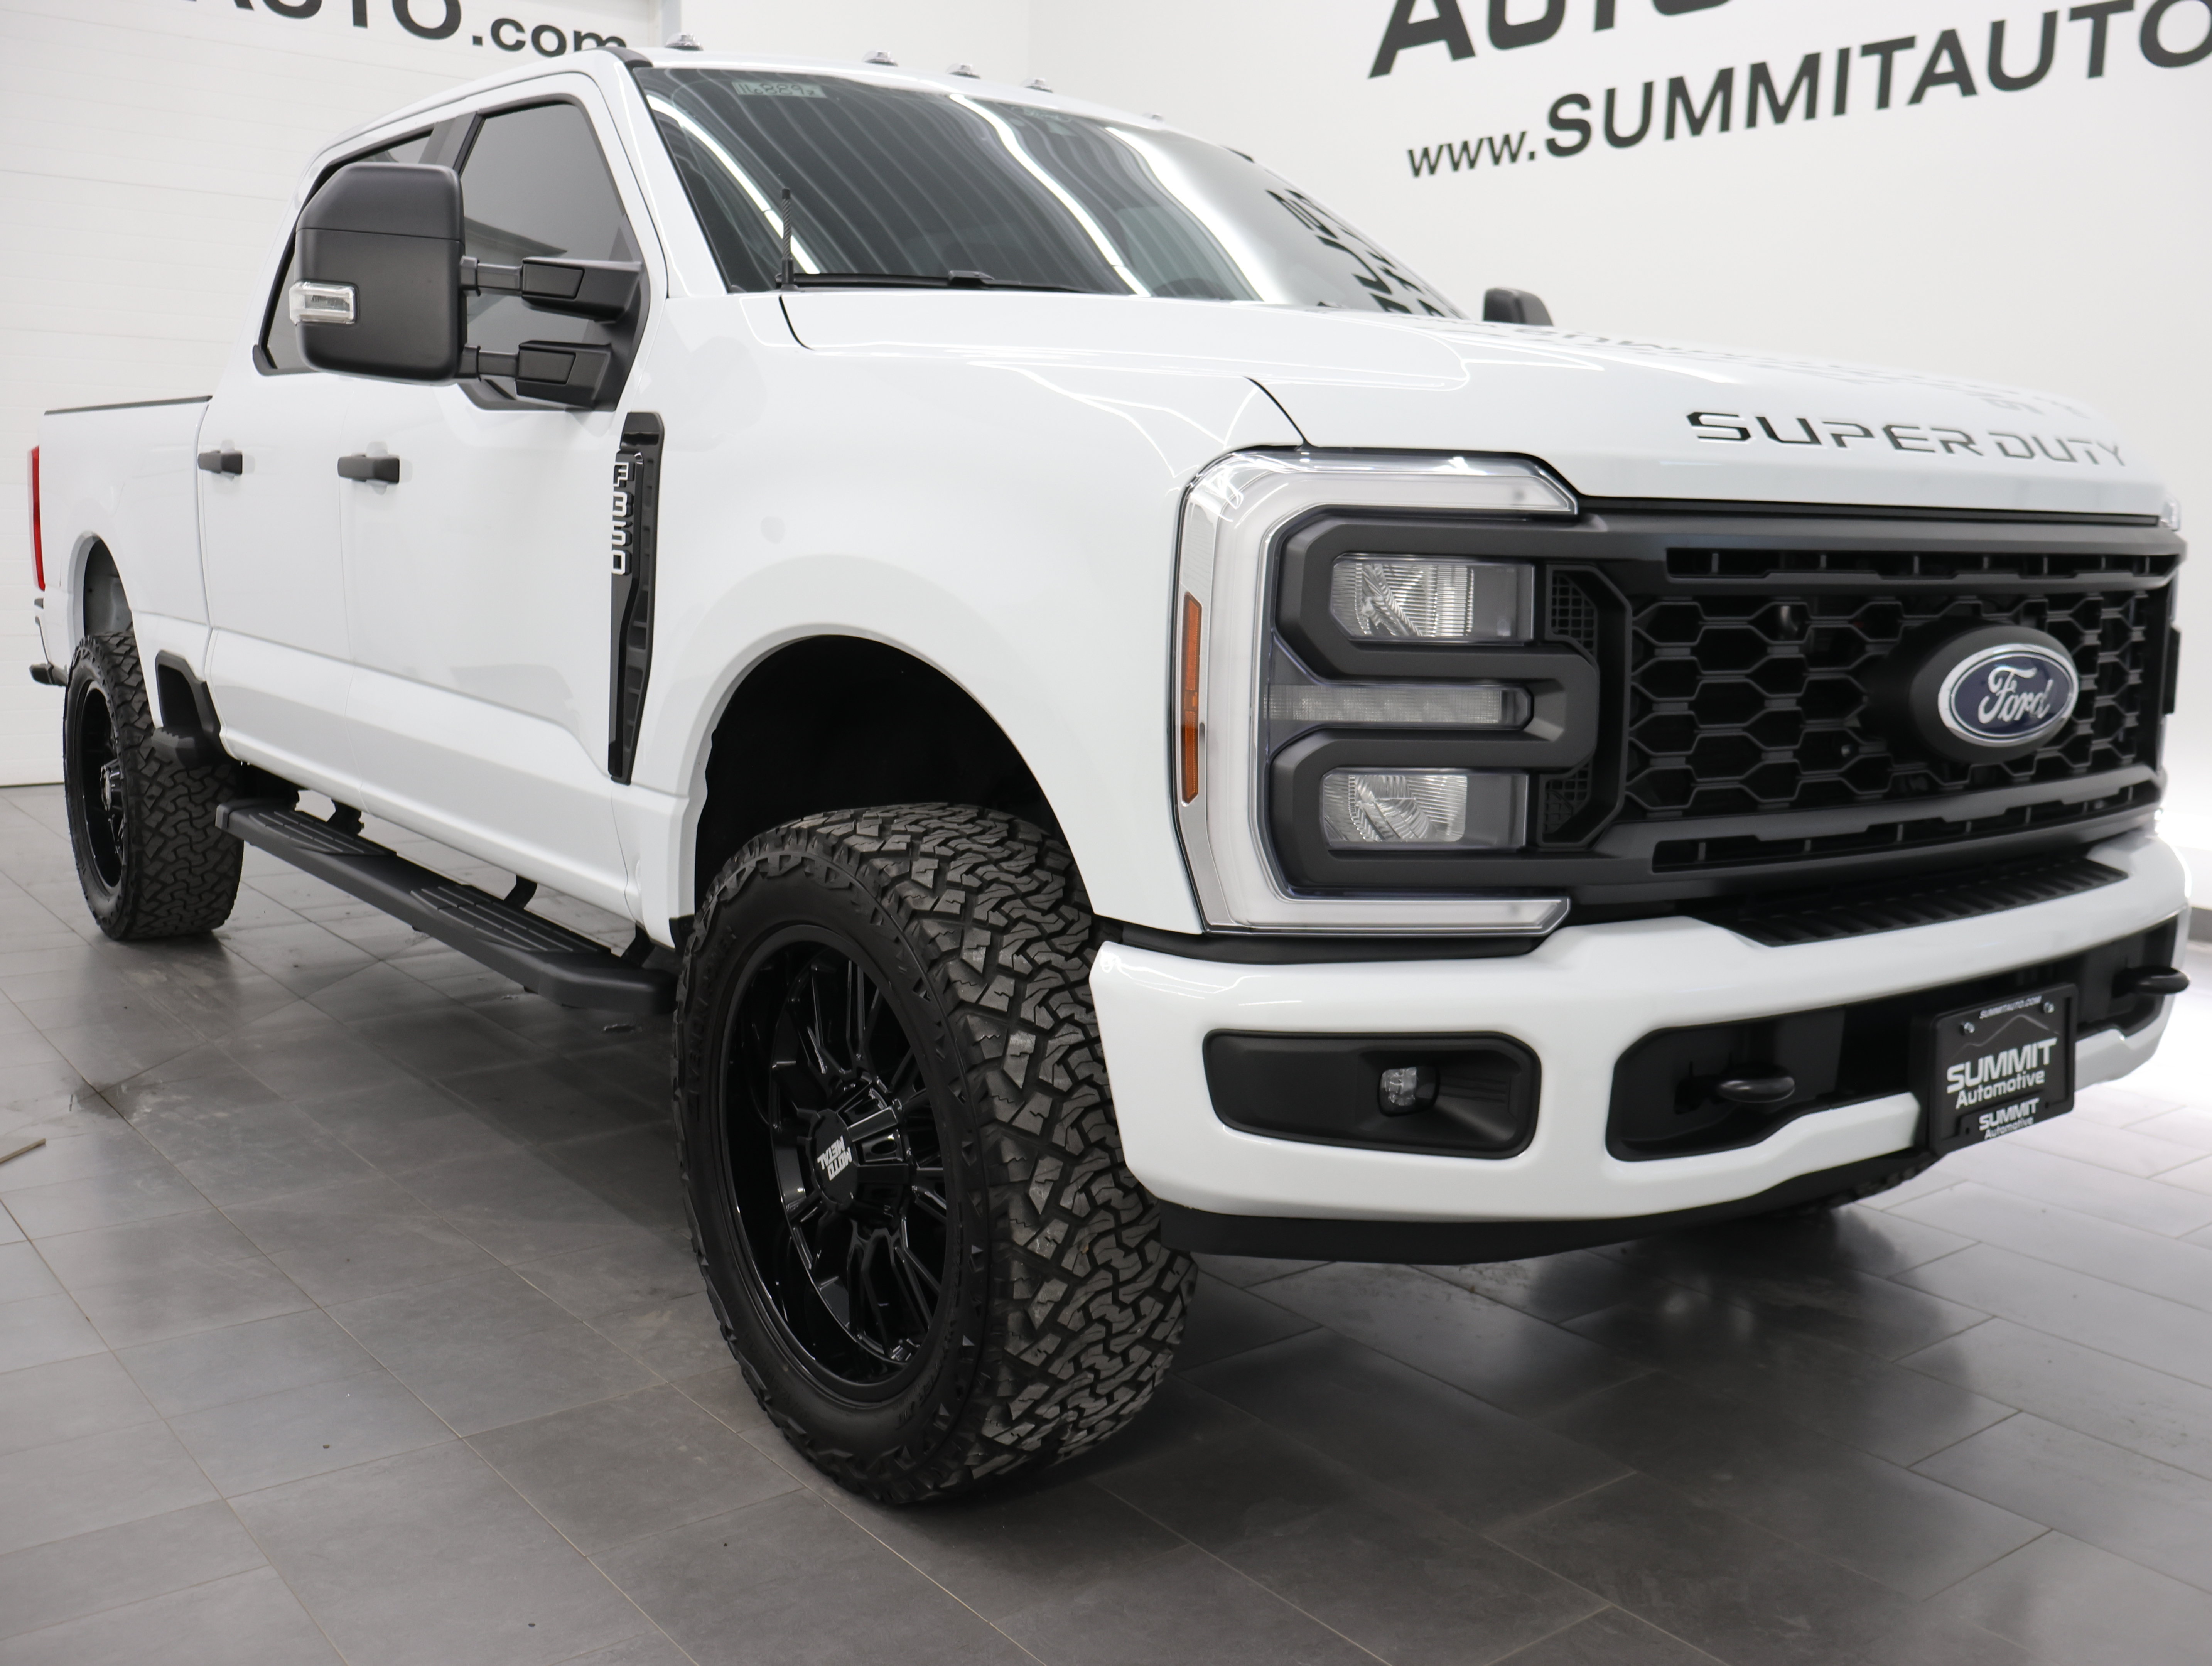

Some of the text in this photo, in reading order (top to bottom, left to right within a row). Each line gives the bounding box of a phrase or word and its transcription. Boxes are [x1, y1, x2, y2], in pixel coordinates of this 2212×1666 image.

[1685, 411, 2126, 466] SUPER DUTY
[611, 462, 630, 575] F350
[1978, 665, 2054, 724] Ford
[1946, 1037, 2058, 1094] SUMMIT
[1955, 1070, 2045, 1110] Automotive
[1979, 1097, 2040, 1131] SUMMIT
[1984, 1117, 2033, 1139] Automotive
[817, 1135, 845, 1170] METAL
[827, 1147, 852, 1181] MOTO
